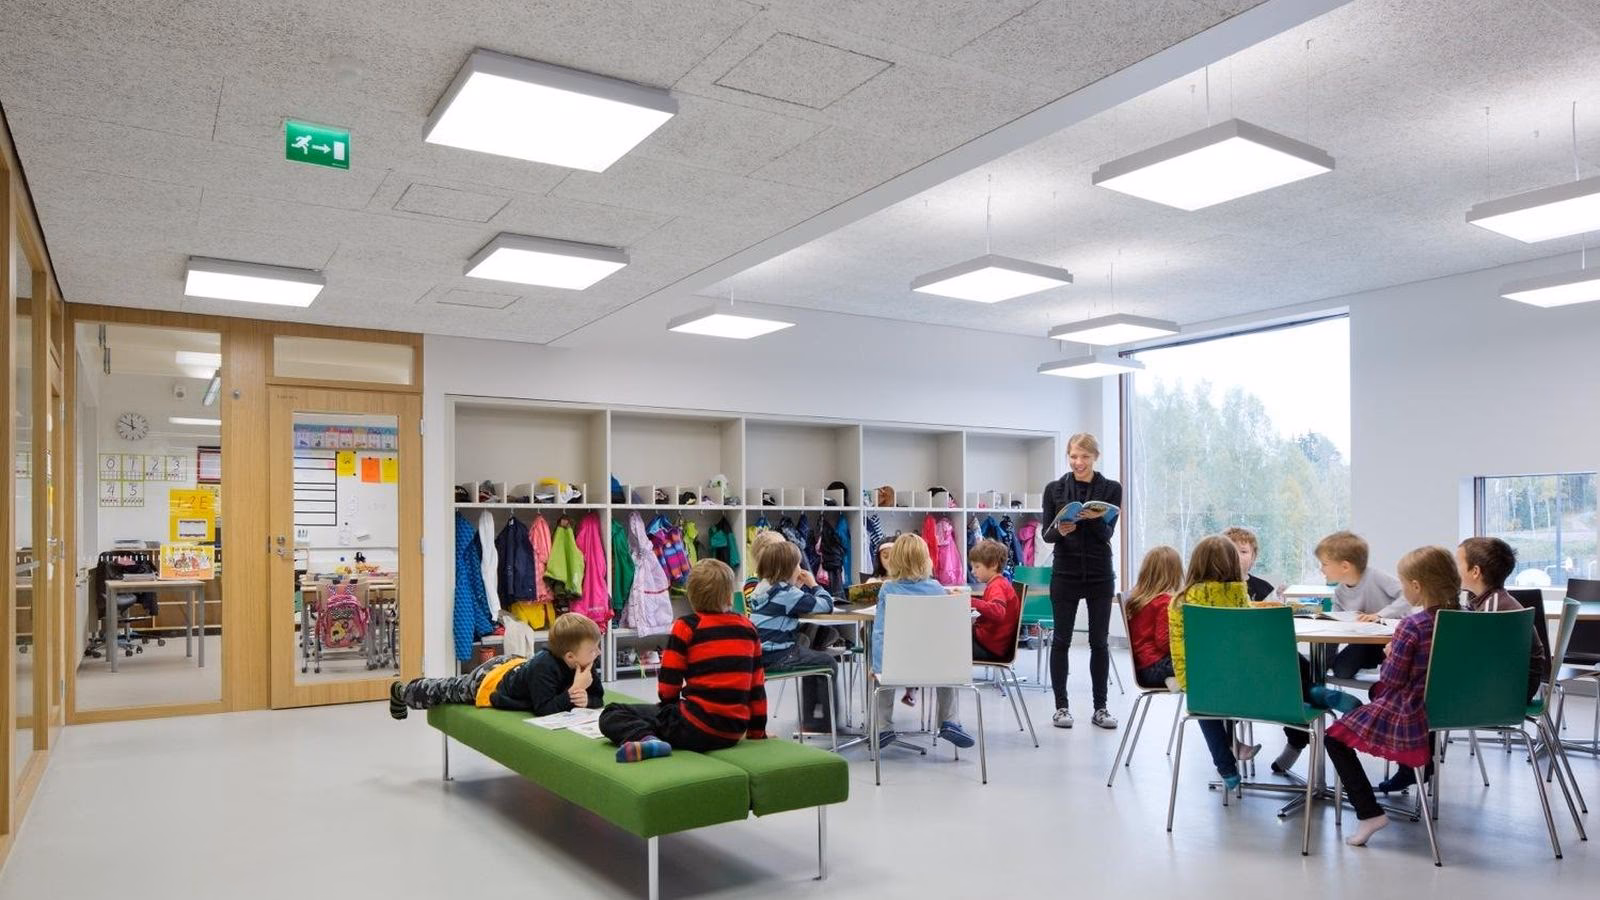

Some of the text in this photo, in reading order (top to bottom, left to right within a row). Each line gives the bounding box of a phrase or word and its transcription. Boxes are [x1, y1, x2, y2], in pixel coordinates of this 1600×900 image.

[106, 458, 115, 469] 0
[151, 459, 159, 471] 2
[173, 460, 180, 471] 3
[107, 484, 115, 496] 4
[129, 485, 138, 496] 5
